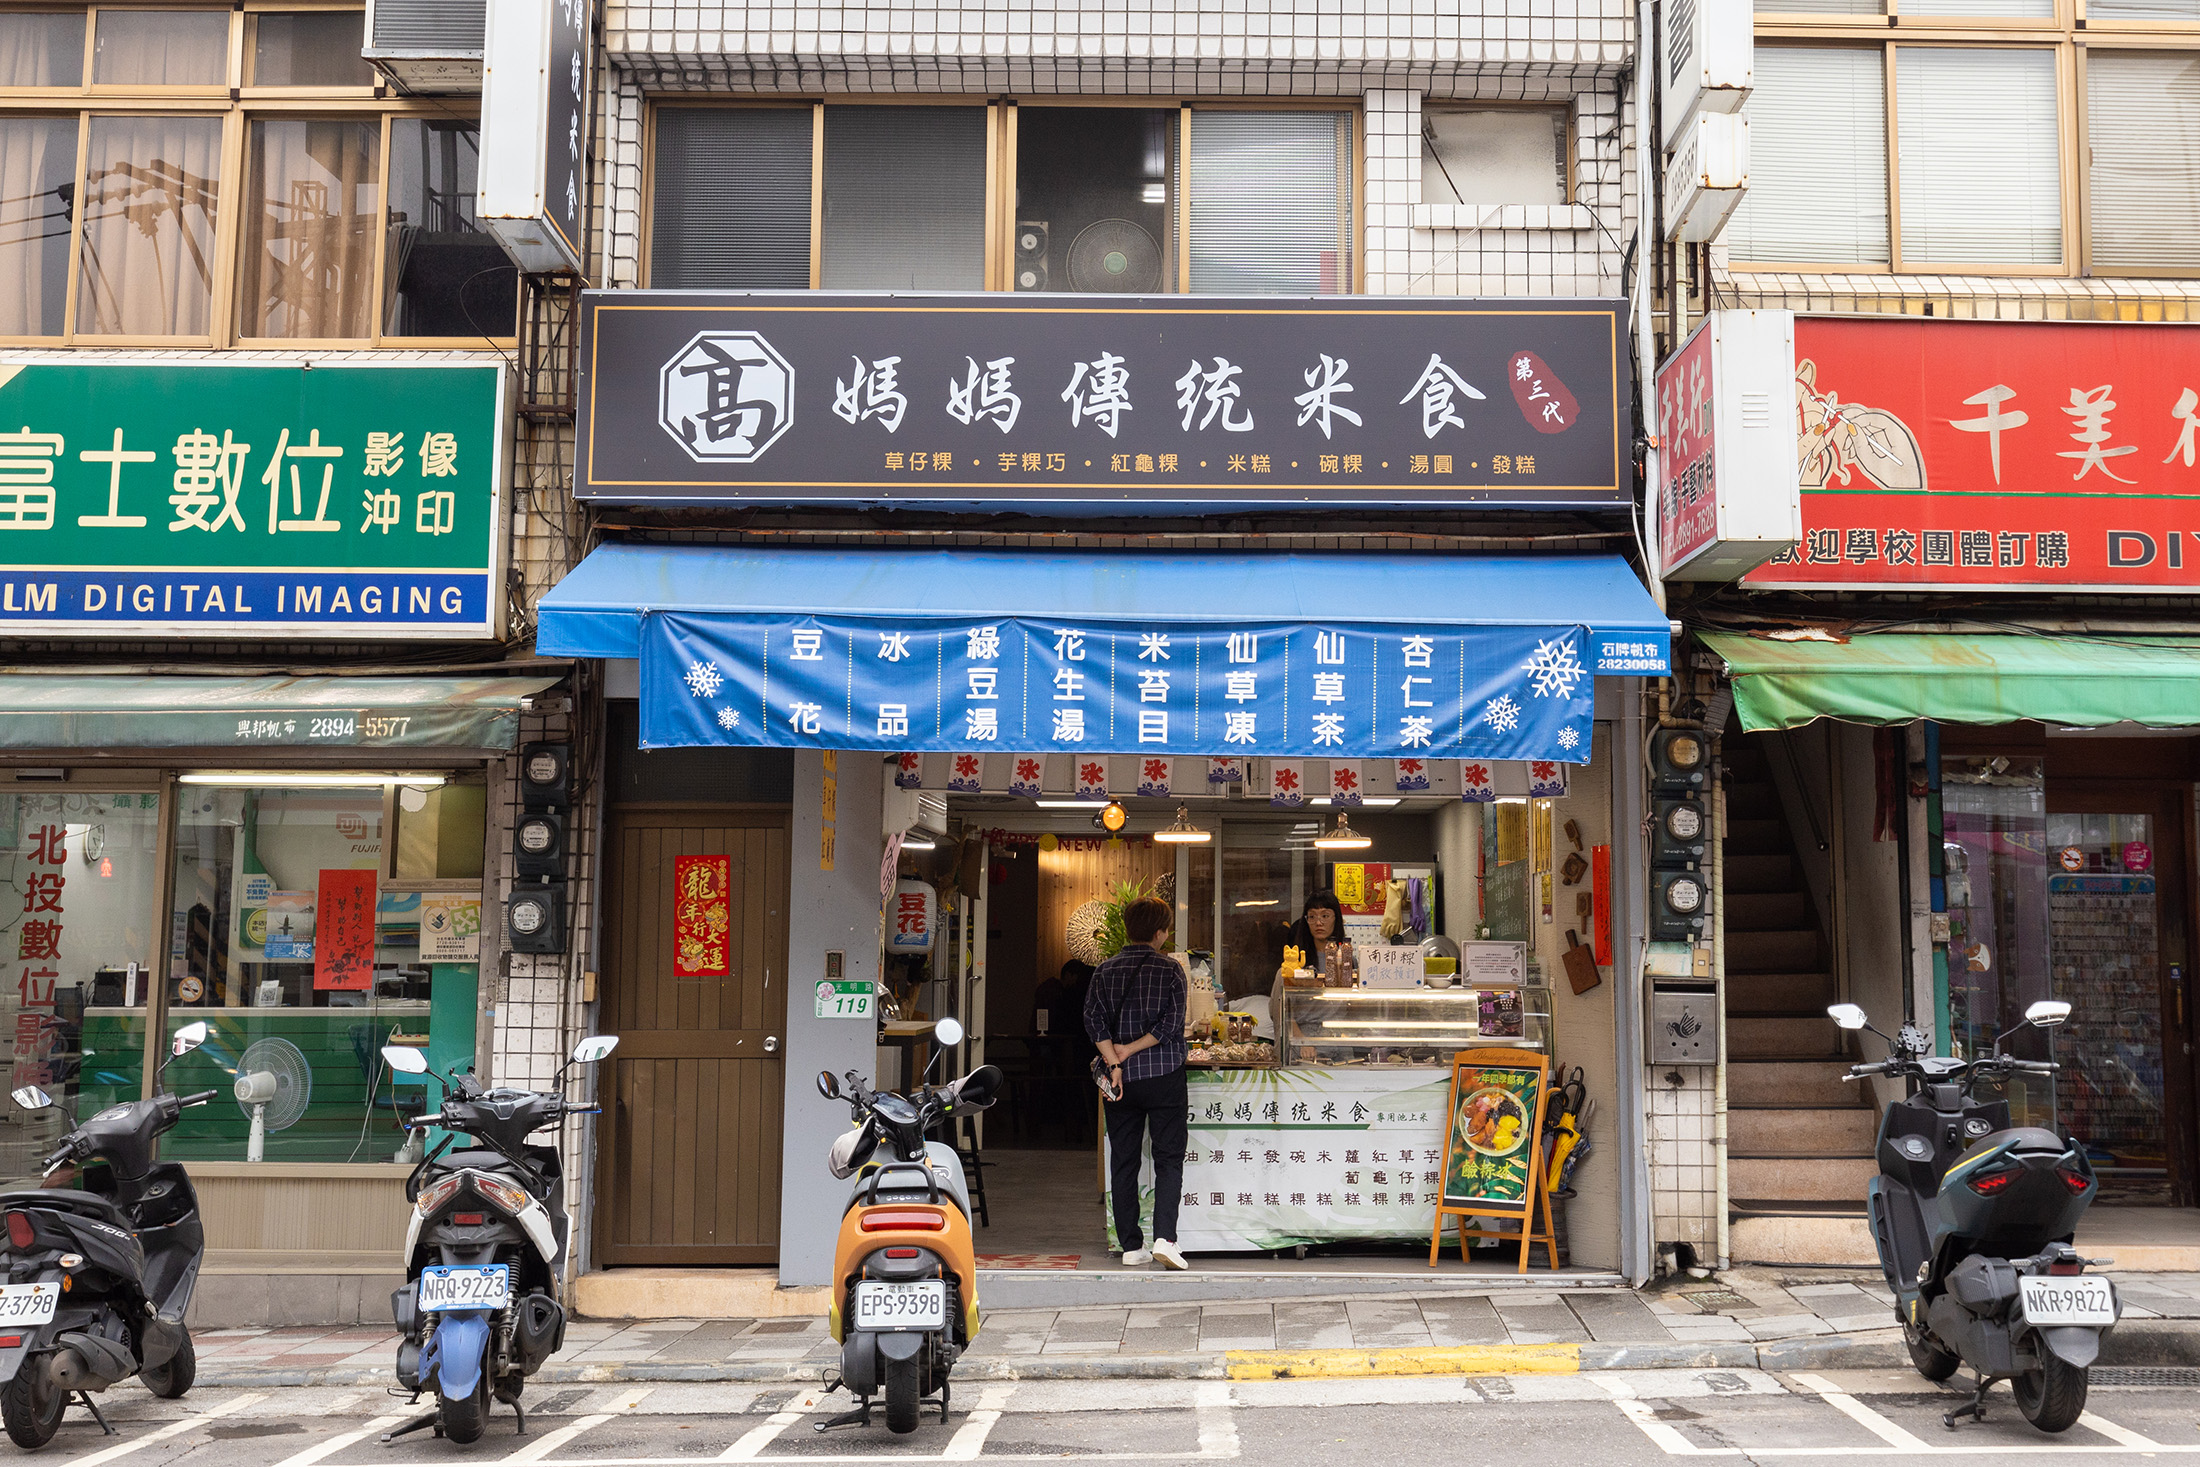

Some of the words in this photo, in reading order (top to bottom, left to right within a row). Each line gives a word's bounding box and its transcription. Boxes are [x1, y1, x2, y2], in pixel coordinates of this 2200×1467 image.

[832, 350, 1486, 439] 媽媽傳統米食
[1514, 356, 1565, 425] 第三代
[0, 426, 343, 534] 富士數位
[363, 431, 458, 477] 影像
[884, 452, 953, 472] 草仔粿
[997, 452, 1066, 472] 芋粿巧
[1110, 453, 1179, 473] 紅龜粿
[1227, 453, 1271, 473] 米糕
[1319, 454, 1363, 474] 碗粿
[1409, 454, 1453, 475] 湯圓
[1491, 454, 1536, 475] 發糕
[360, 488, 455, 536] 沖印
[2107, 530, 2200, 569] DI
[84, 584, 253, 613] DIGITAL
[277, 585, 464, 615] IMAGING
[1597, 658, 1666, 670] 28230058
[1601, 642, 1658, 657] 石牌帆布
[789, 629, 824, 734] 豆花
[877, 632, 910, 736] 冰品
[965, 627, 999, 742] 綠豆湯
[1051, 628, 1086, 742] 花生湯
[1137, 633, 1171, 743] 米苔目
[1224, 632, 1258, 745] 仙草凍
[1312, 631, 1345, 747] 仙草茶
[1399, 634, 1433, 748] 杏仁茶
[309, 717, 411, 737] 2894-5577
[1058, 837, 1101, 851] NEW
[897, 893, 927, 933] 豆花
[836, 998, 867, 1013] 119
[1209, 1150, 1225, 1206] 湯圓
[1237, 1150, 1253, 1206] 年糕
[1264, 1150, 1280, 1206] 發糕
[1289, 1150, 1306, 1206] 碗粿
[1316, 1150, 1333, 1206] 米糕
[1344, 1150, 1361, 1206] 蘿蔔糕
[1372, 1150, 1388, 1206] 紅龜粿
[1399, 1150, 1415, 1206] 草仔粿
[1423, 1150, 1440, 1206] 芋粿巧
